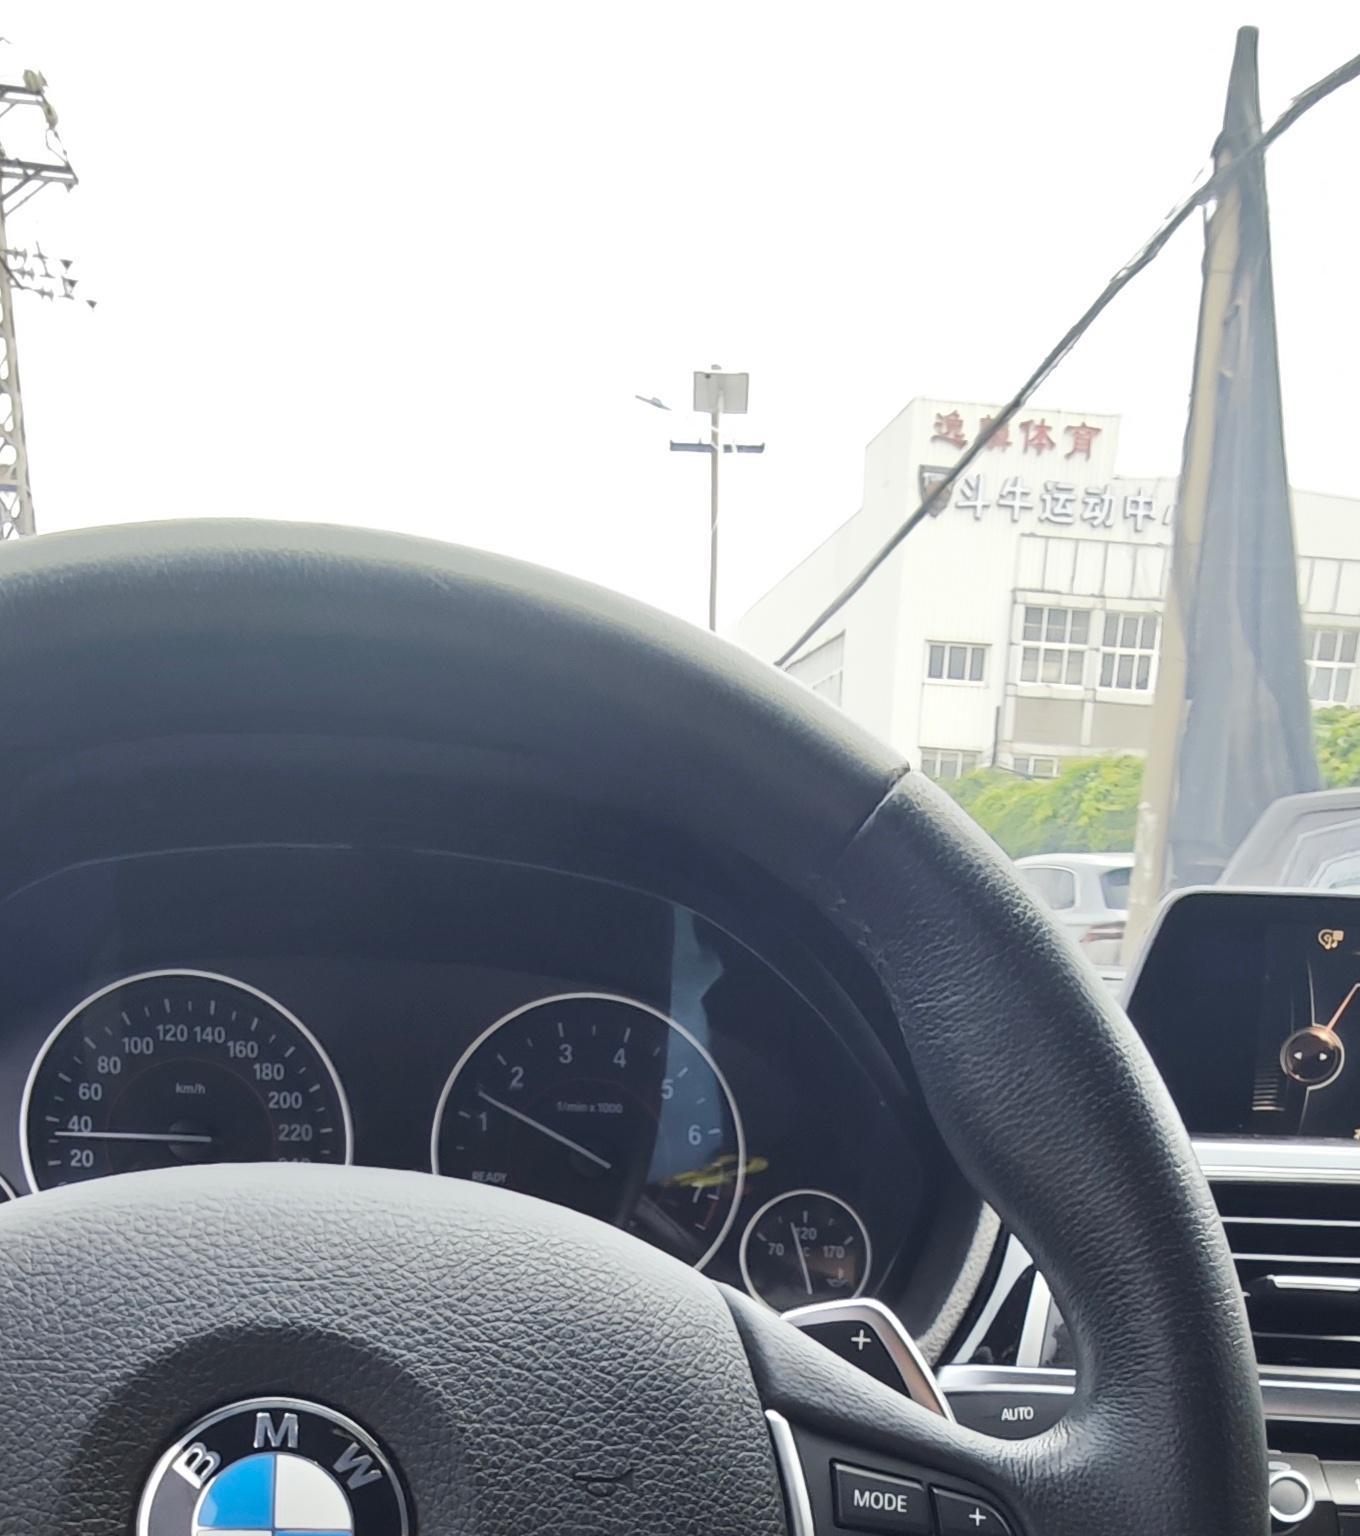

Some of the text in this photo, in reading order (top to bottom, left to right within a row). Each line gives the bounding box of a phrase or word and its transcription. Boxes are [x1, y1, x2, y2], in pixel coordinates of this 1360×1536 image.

[955, 473, 1174, 532] 斗牛运动中
[156, 1023, 189, 1043] 120
[193, 1024, 226, 1045] 140
[122, 1036, 154, 1056] 100
[226, 1040, 259, 1059] 160
[558, 1043, 574, 1064] 3
[96, 1056, 122, 1075] 80
[612, 1048, 628, 1068] 4
[253, 1062, 285, 1081] 180
[509, 1066, 525, 1089] 2
[78, 1083, 103, 1102] 60
[175, 1082, 207, 1096] km/h
[661, 1078, 674, 1100] 5
[268, 1090, 304, 1110] 200
[67, 1115, 93, 1135] 40
[478, 1111, 488, 1132] 1
[277, 1123, 313, 1142] 220
[688, 1125, 702, 1146] 6
[69, 1149, 94, 1168] 20
[472, 1171, 508, 1184] READY
[768, 1242, 784, 1257] 70
[822, 1245, 845, 1258] 170
[1001, 1406, 1034, 1421] AUTO
[171, 1411, 383, 1490] BMW
[1355, 1479, 1360, 1493] 1
[853, 1489, 908, 1513] MODE
